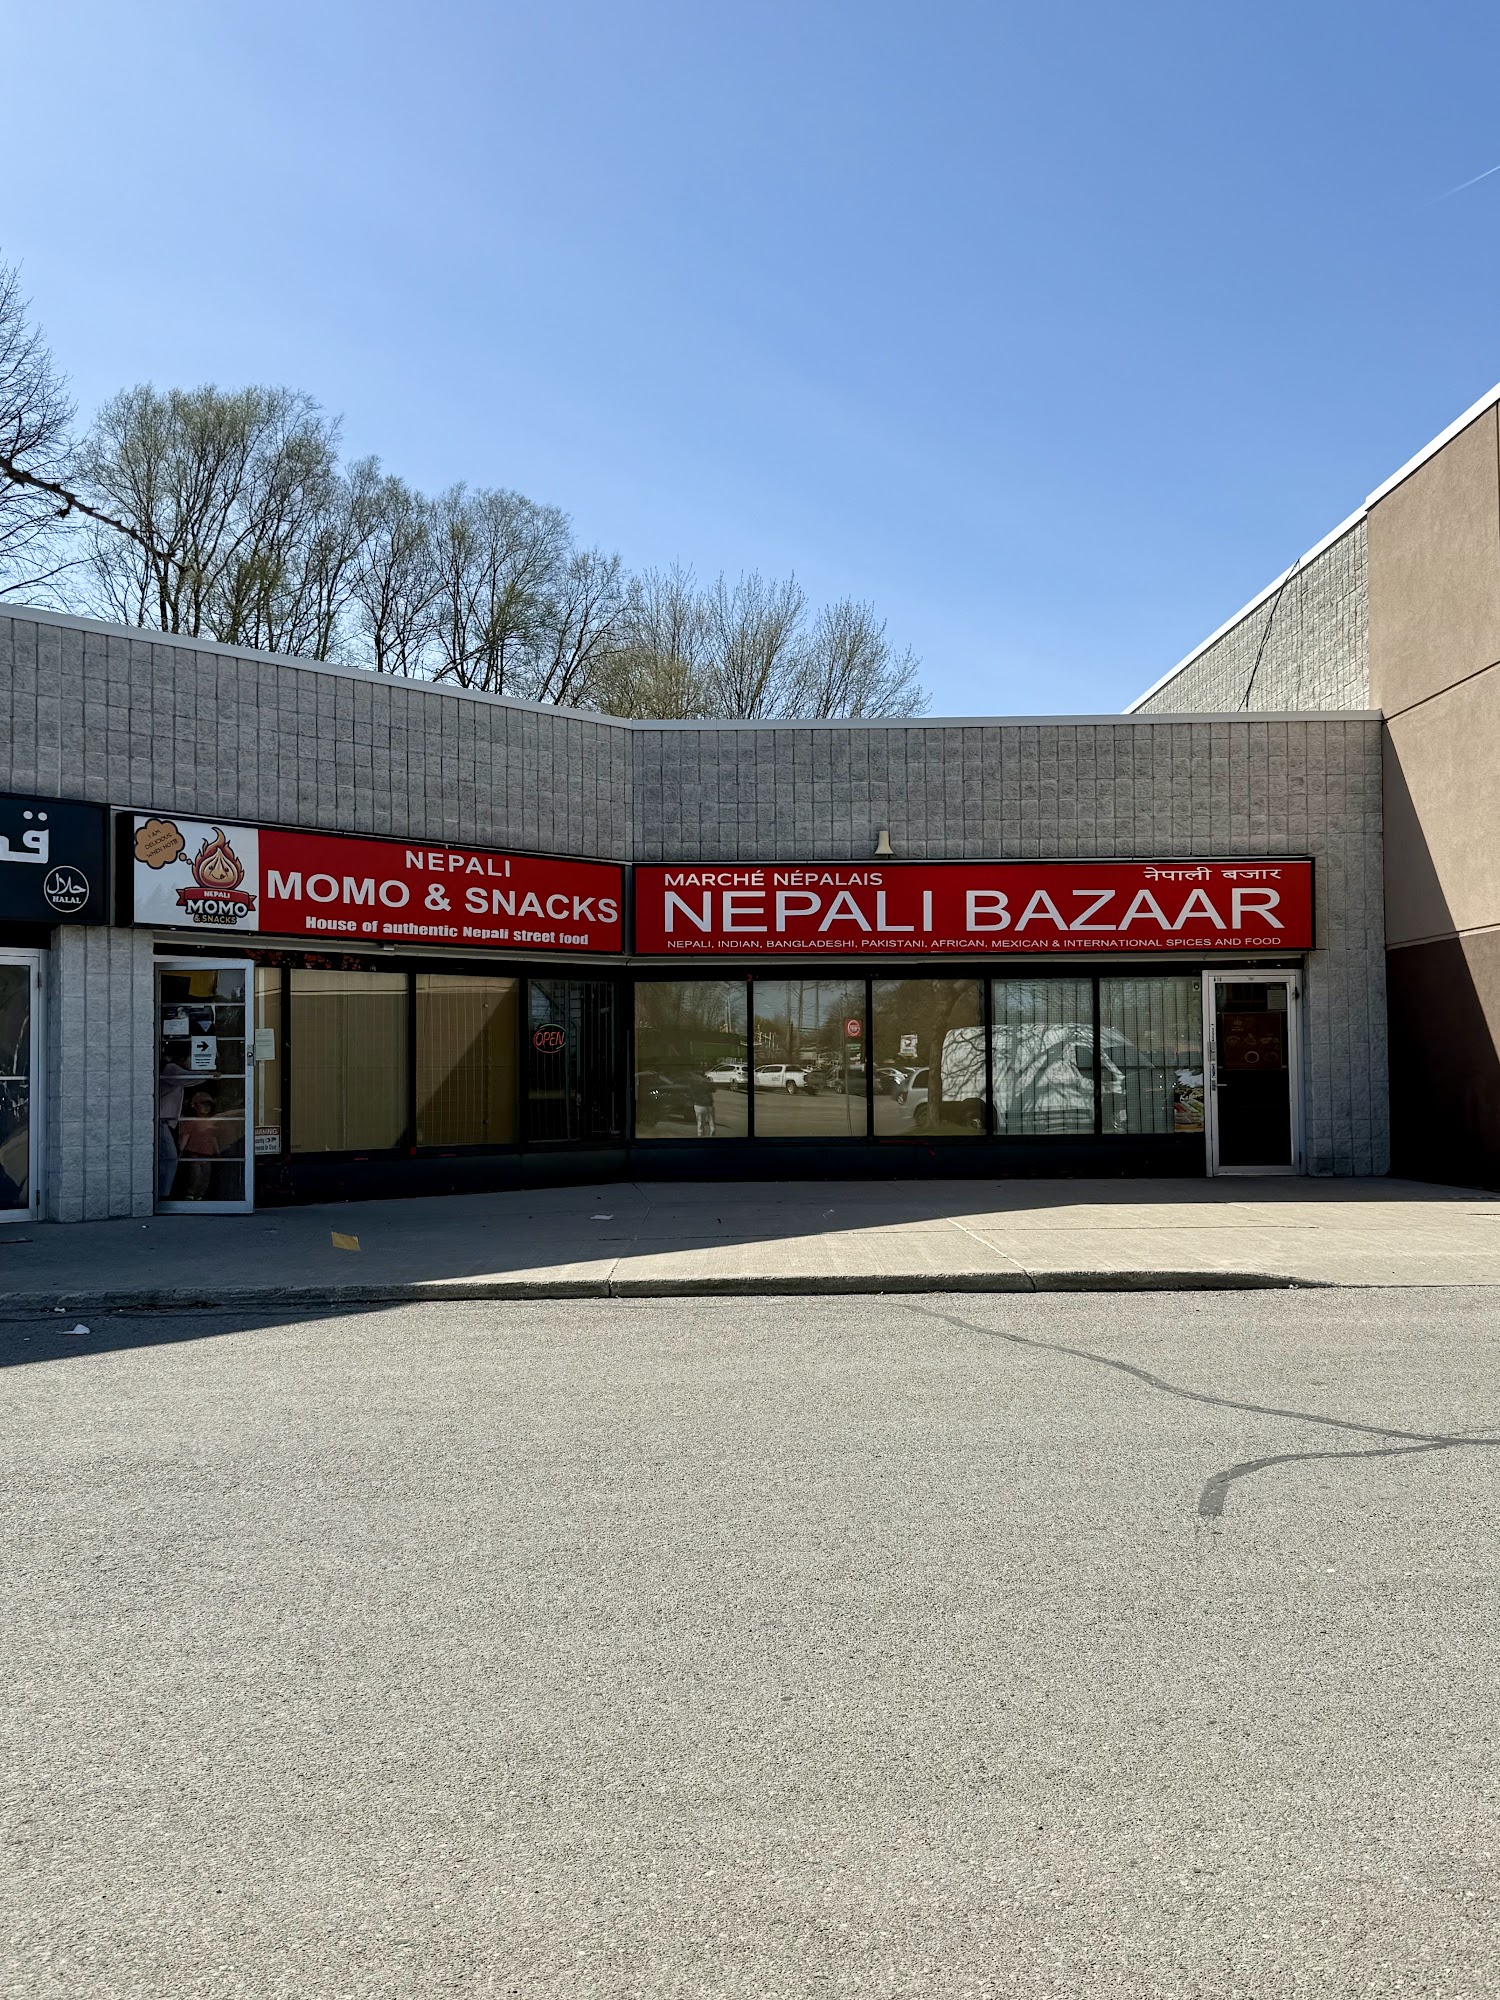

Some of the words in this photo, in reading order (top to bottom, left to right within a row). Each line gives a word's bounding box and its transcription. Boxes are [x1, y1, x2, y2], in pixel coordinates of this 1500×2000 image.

[144, 832, 173, 850] DELICIOUS
[152, 829, 162, 838] AM
[146, 846, 163, 858] WHEN
[405, 850, 511, 878] NEPALI
[664, 869, 765, 887] MARCHÉ
[773, 869, 883, 886] NÉPALAIS
[1143, 866, 1213, 882] नेपाली
[1220, 869, 1282, 881] बजार
[46, 872, 87, 895] حلال
[52, 895, 82, 904] HALAL
[203, 890, 231, 899] NEPALI
[267, 869, 412, 908] MOMO
[424, 883, 452, 912] &
[464, 886, 618, 923] SNACKS
[186, 899, 248, 917] MOMO
[664, 890, 933, 933] NEPALI
[965, 887, 1285, 932] BAZAAR
[193, 914, 201, 922] &
[202, 914, 237, 924] SNACKS
[305, 915, 357, 932] House
[361, 919, 379, 933] of
[382, 922, 459, 938] authentic
[462, 926, 509, 940] Nepali
[513, 929, 556, 943] street
[558, 932, 589, 945] food
[667, 940, 714, 949] NEPALI,
[718, 940, 763, 949] INDIAN,
[991, 939, 1049, 948] MEXICAN
[1052, 939, 1061, 948] &
[1063, 939, 1163, 948] INTERNATIONAL
[1166, 938, 1212, 947] SPICES
[1215, 937, 1242, 946] AND
[1245, 937, 1281, 946] FOOD
[535, 1031, 565, 1046] OPEN
